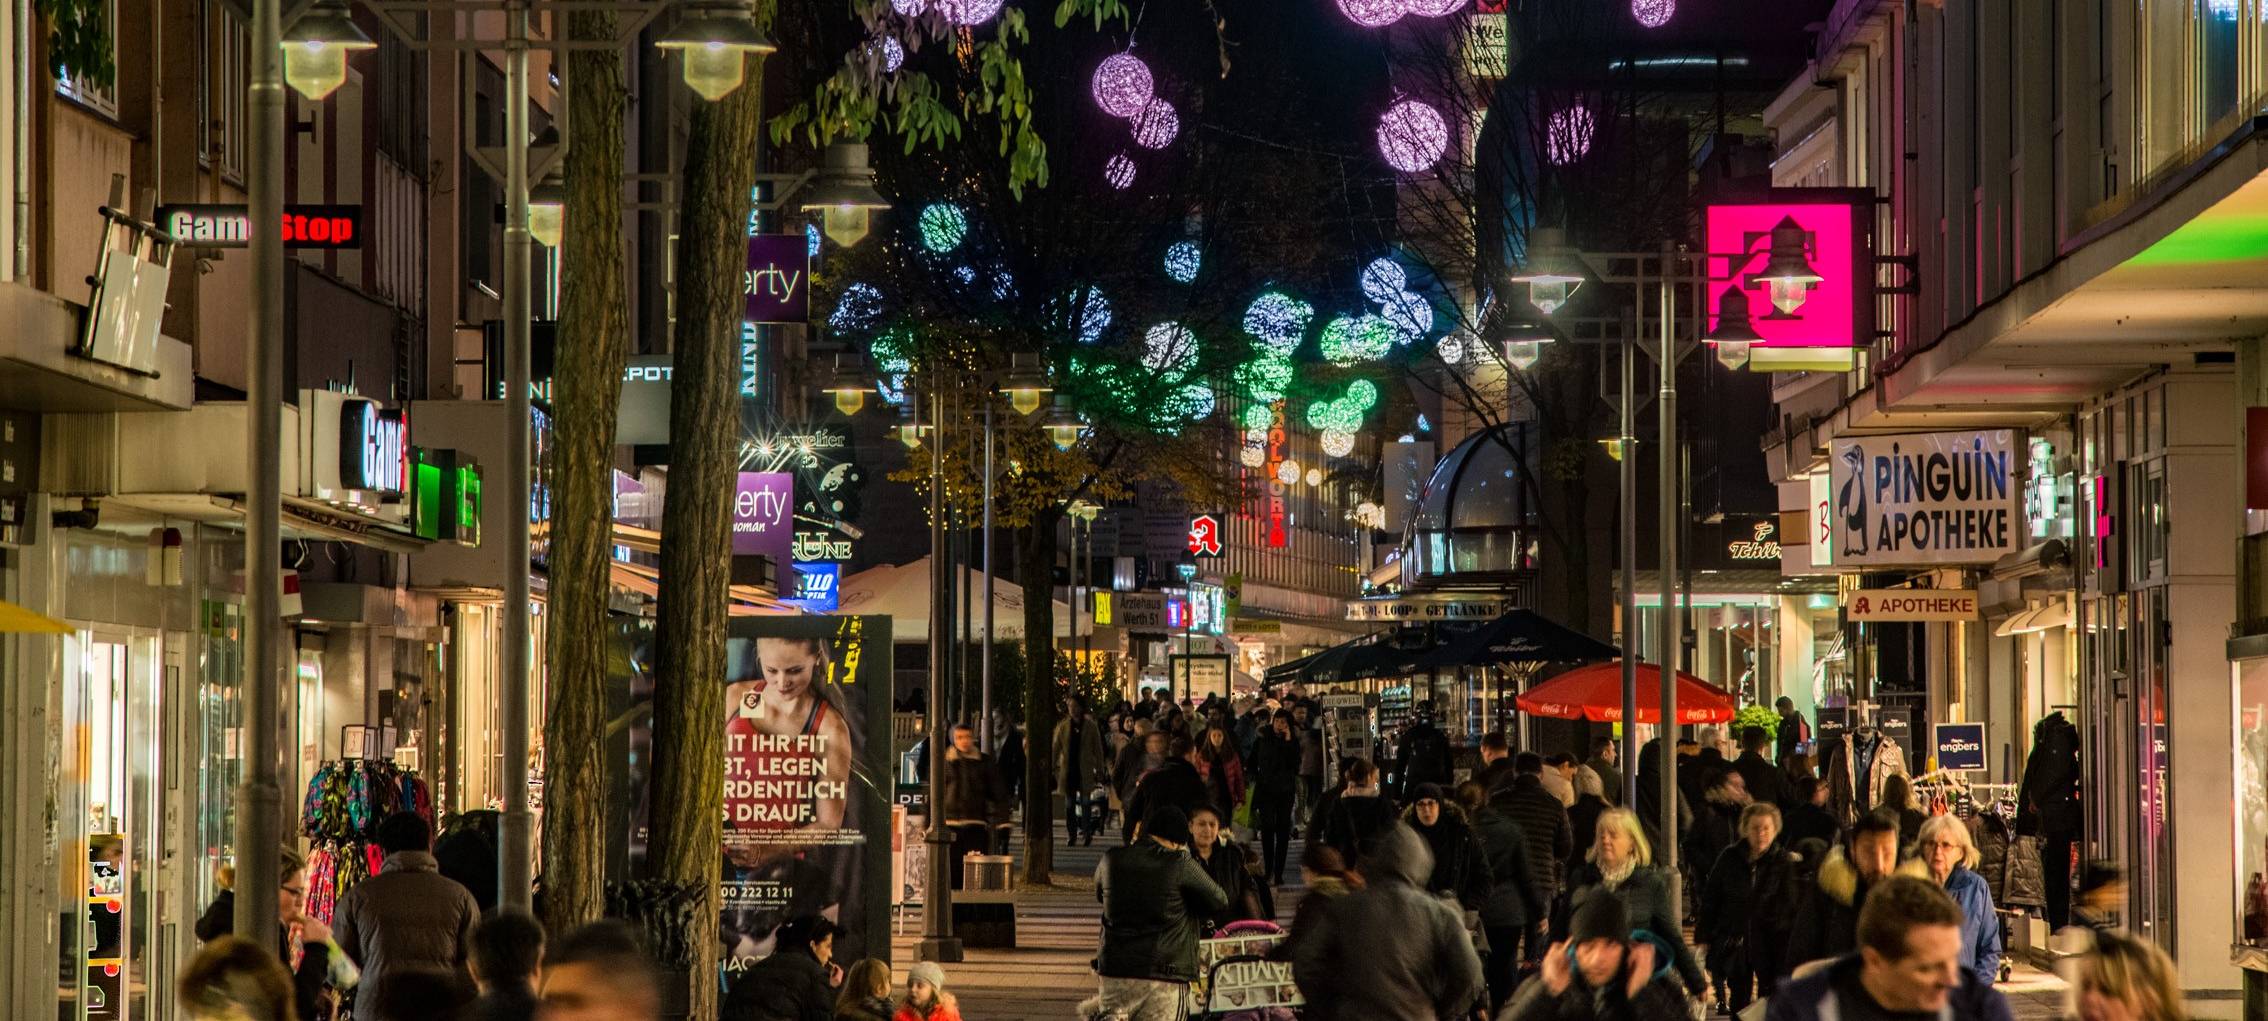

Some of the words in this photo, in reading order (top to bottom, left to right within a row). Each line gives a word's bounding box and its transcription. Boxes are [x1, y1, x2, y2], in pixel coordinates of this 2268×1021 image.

[171, 211, 352, 243] GamStop
[623, 367, 673, 381] POT
[1877, 508, 2008, 551] APOTHEKE
[805, 573, 834, 590] LLO
[1425, 603, 1496, 616] GETRÄNKE
[1879, 598, 1973, 614] APOTHEKE
[1123, 611, 1148, 625] Werth
[752, 734, 790, 753] IHR
[797, 734, 829, 753] FIT
[1940, 742, 1979, 753] engbers
[758, 757, 828, 776] LEGEN
[736, 803, 817, 822] DRAUF.
[741, 887, 762, 898] 222
[767, 887, 778, 898] 12
[783, 887, 793, 898] 11
